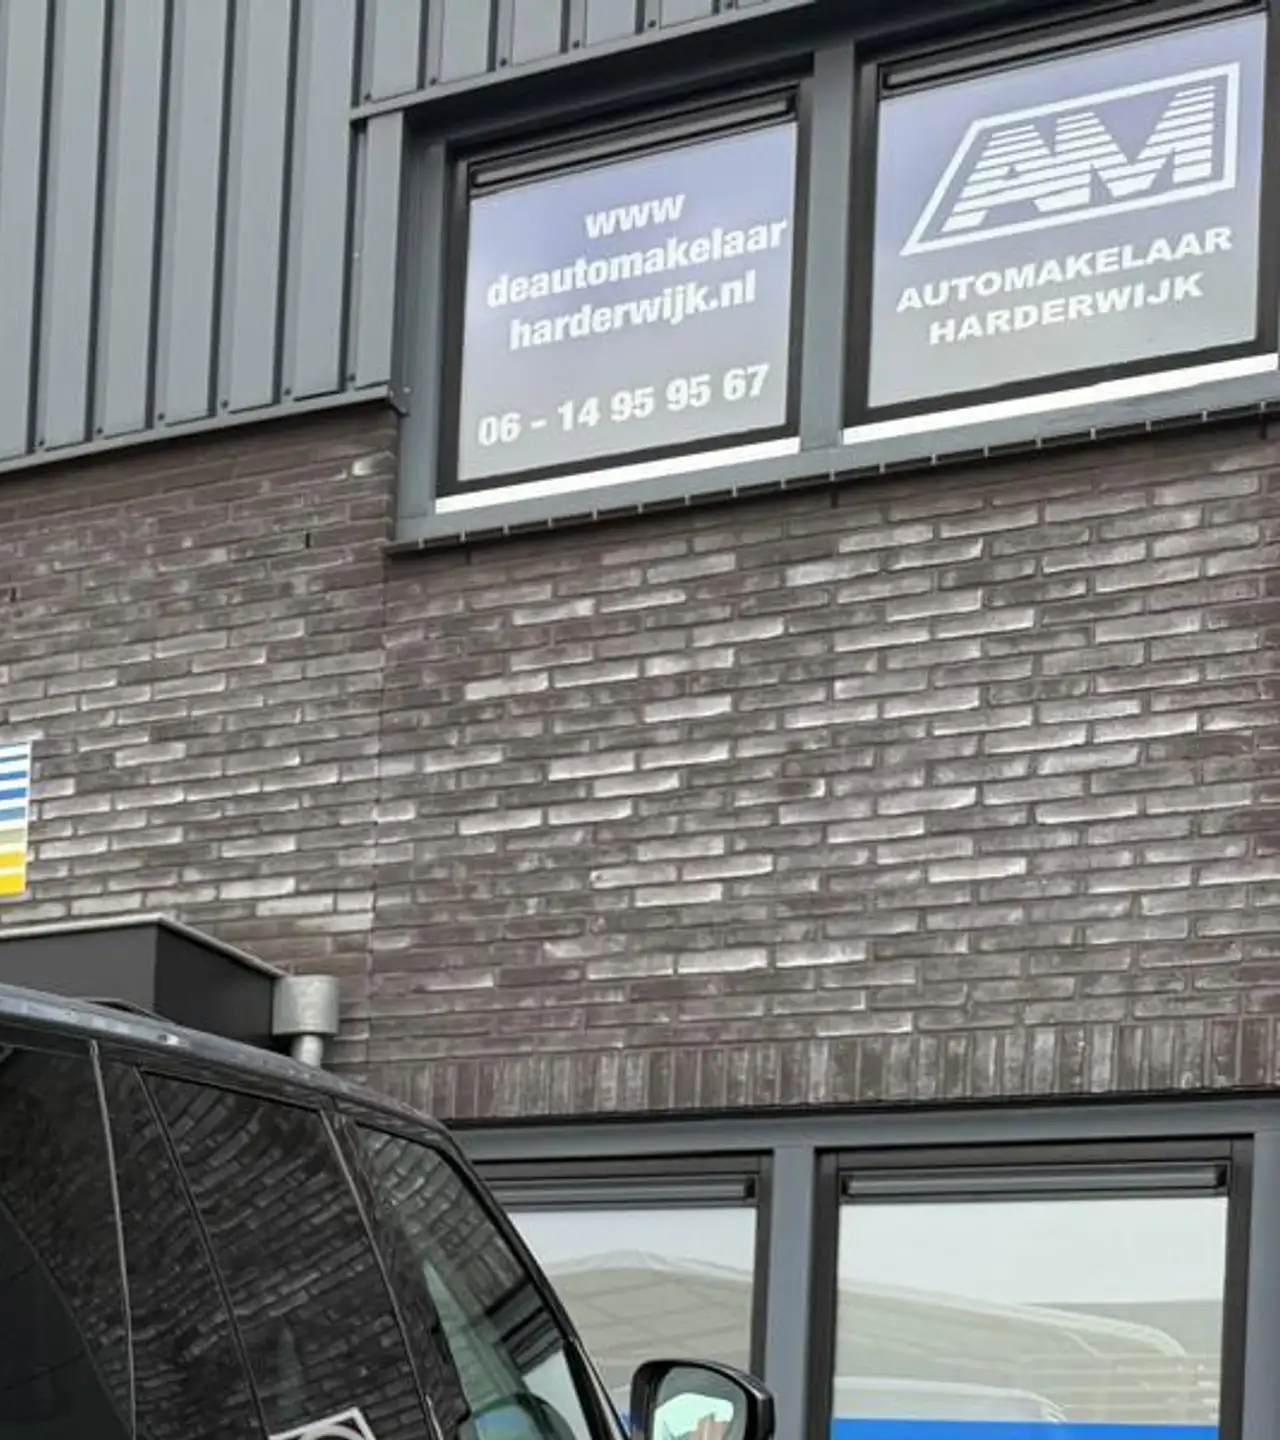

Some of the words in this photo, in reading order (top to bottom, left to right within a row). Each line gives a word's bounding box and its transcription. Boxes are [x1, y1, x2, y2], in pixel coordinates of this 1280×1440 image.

[585, 191, 686, 238] www
[486, 217, 788, 309] deautomakelaar
[896, 225, 1233, 312] AUTOMAKELAAR
[509, 271, 757, 351] harderwijk.nl
[928, 271, 1203, 346] HARDERWIJK
[477, 412, 520, 446] 06
[557, 400, 600, 432] 14
[610, 388, 655, 423] 95
[666, 378, 712, 412] 95
[722, 364, 770, 400] 67
